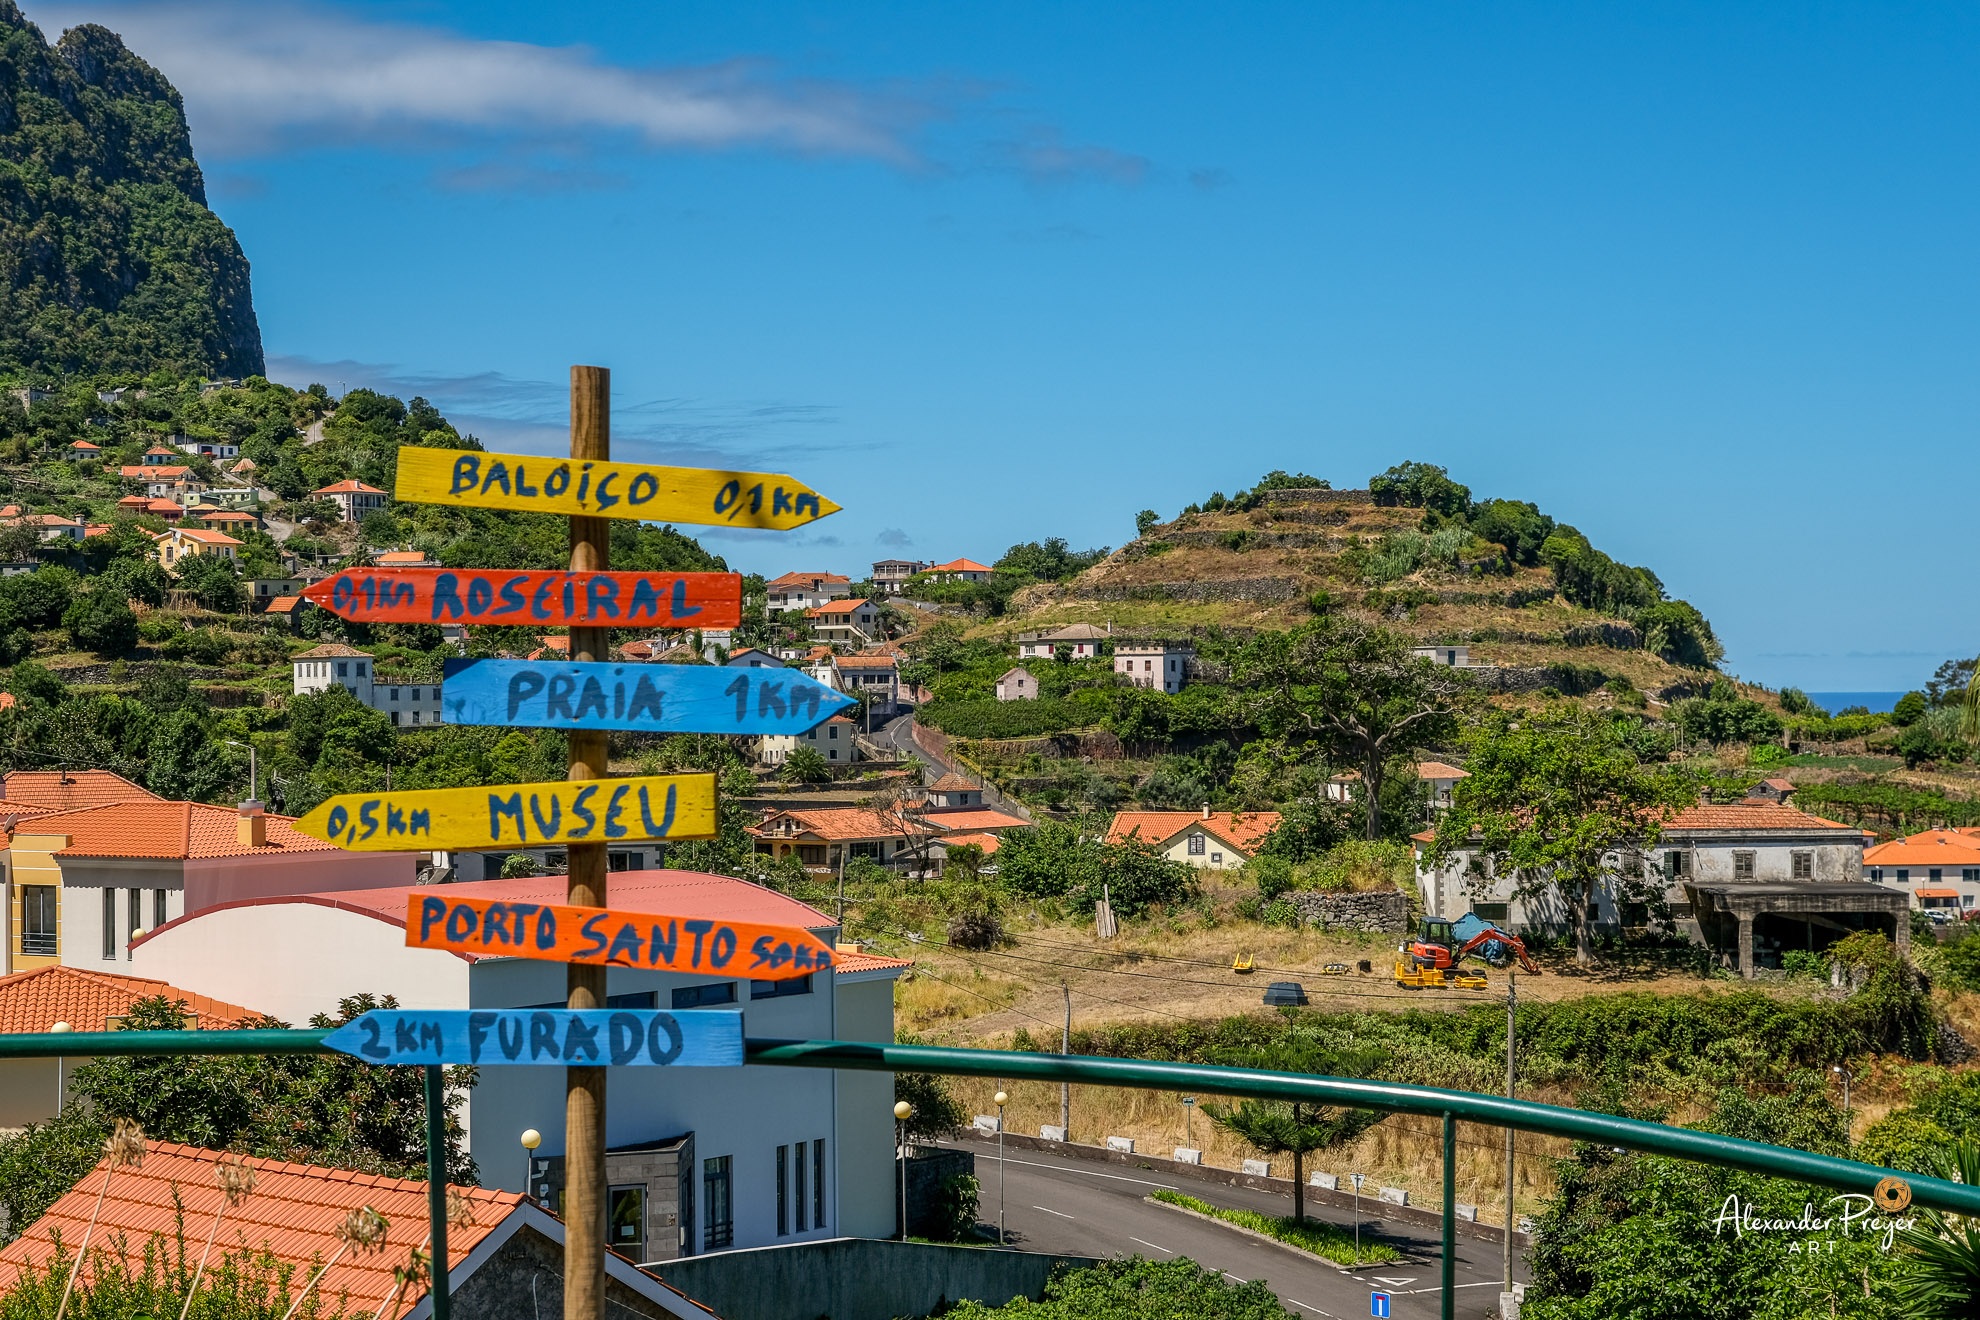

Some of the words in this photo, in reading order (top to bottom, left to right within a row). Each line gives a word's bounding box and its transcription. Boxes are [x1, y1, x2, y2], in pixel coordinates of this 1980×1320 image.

[489, 783, 677, 842] MUSEU
[420, 896, 556, 950] PORTO
[571, 913, 737, 969] SANTO
[468, 1010, 684, 1066] FURADO
